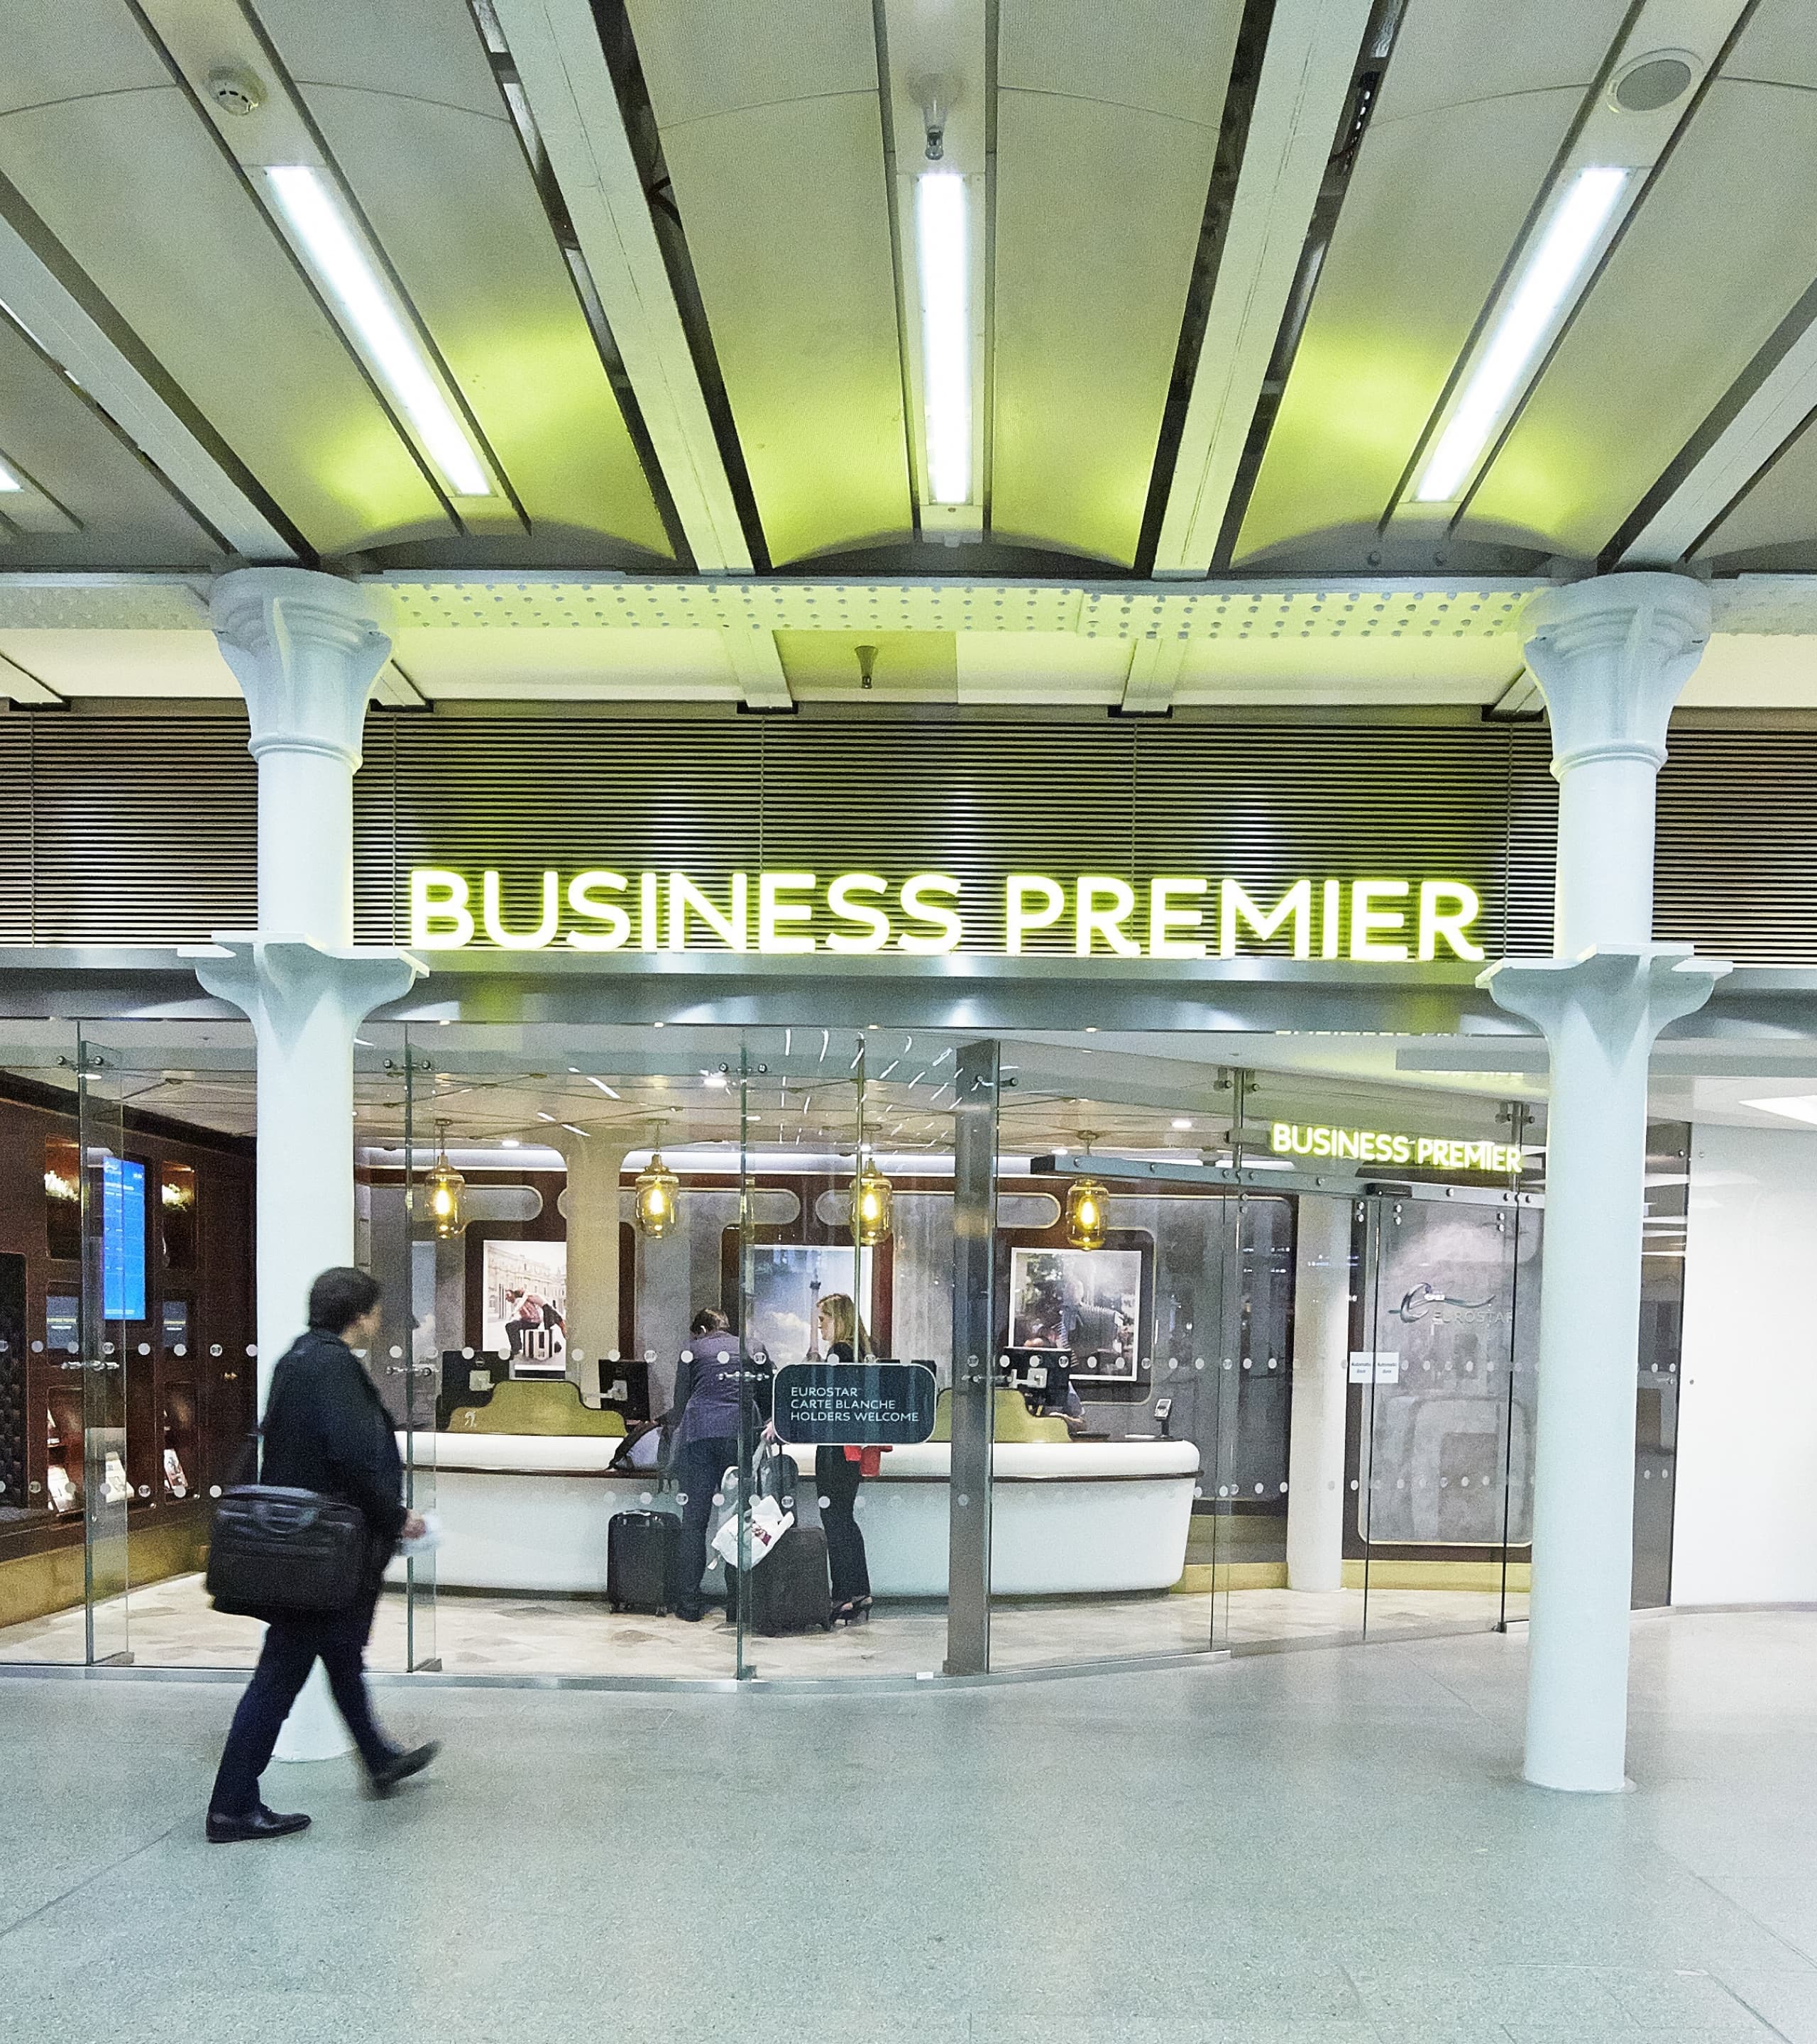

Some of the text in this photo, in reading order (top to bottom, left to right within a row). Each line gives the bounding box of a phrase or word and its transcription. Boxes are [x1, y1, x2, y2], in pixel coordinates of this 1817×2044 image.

[410, 869, 1486, 962] BUSINESS PREMIER
[1273, 1123, 1522, 1173] BUSINESS PREMIER
[791, 1387, 858, 1397] EUROSTAR
[791, 1399, 896, 1410] CARTE BLANCHE
[791, 1412, 919, 1422] HOLDERS WELCOME
